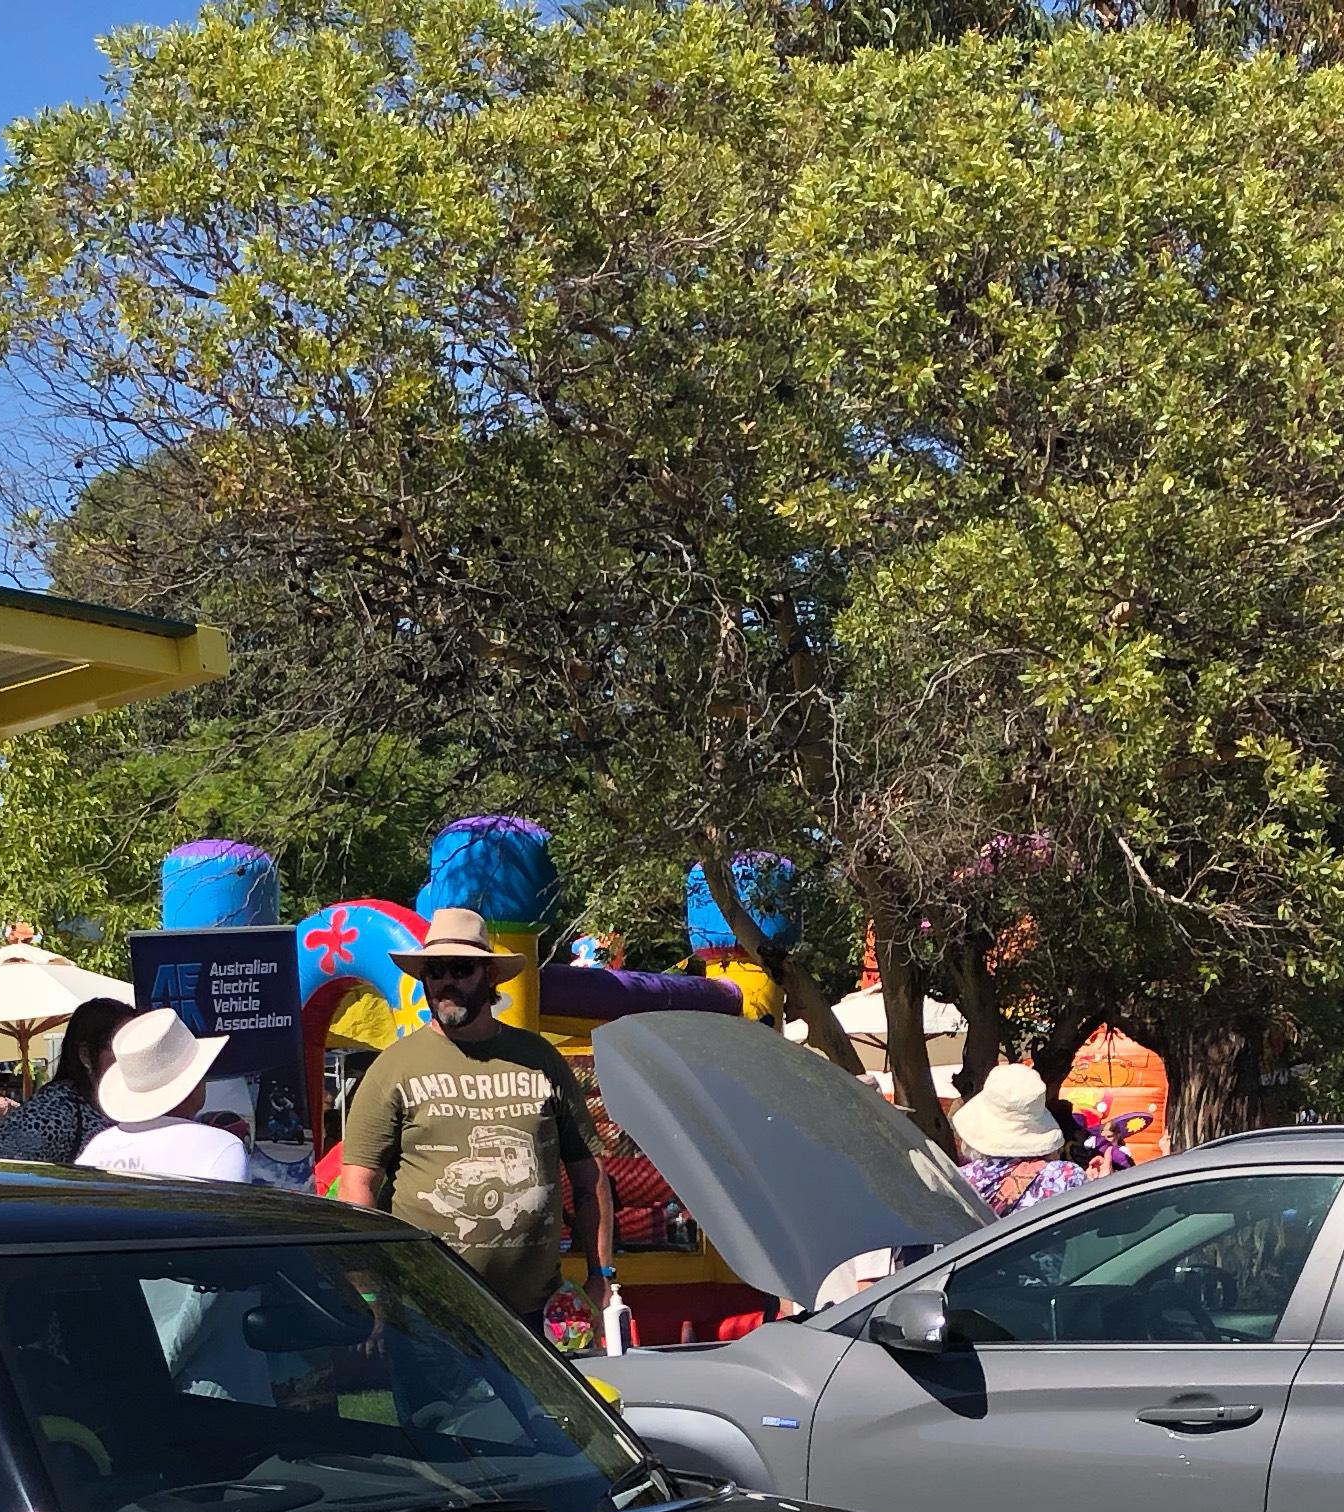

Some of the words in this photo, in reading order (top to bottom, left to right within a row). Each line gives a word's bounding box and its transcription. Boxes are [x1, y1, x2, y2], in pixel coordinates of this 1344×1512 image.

[210, 959, 278, 977] Australian
[211, 978, 261, 995] Electric
[213, 996, 261, 1013] Vehicle
[215, 1012, 292, 1032] Association
[396, 1073, 458, 1109] LAND
[459, 1071, 561, 1101] CRUISIN
